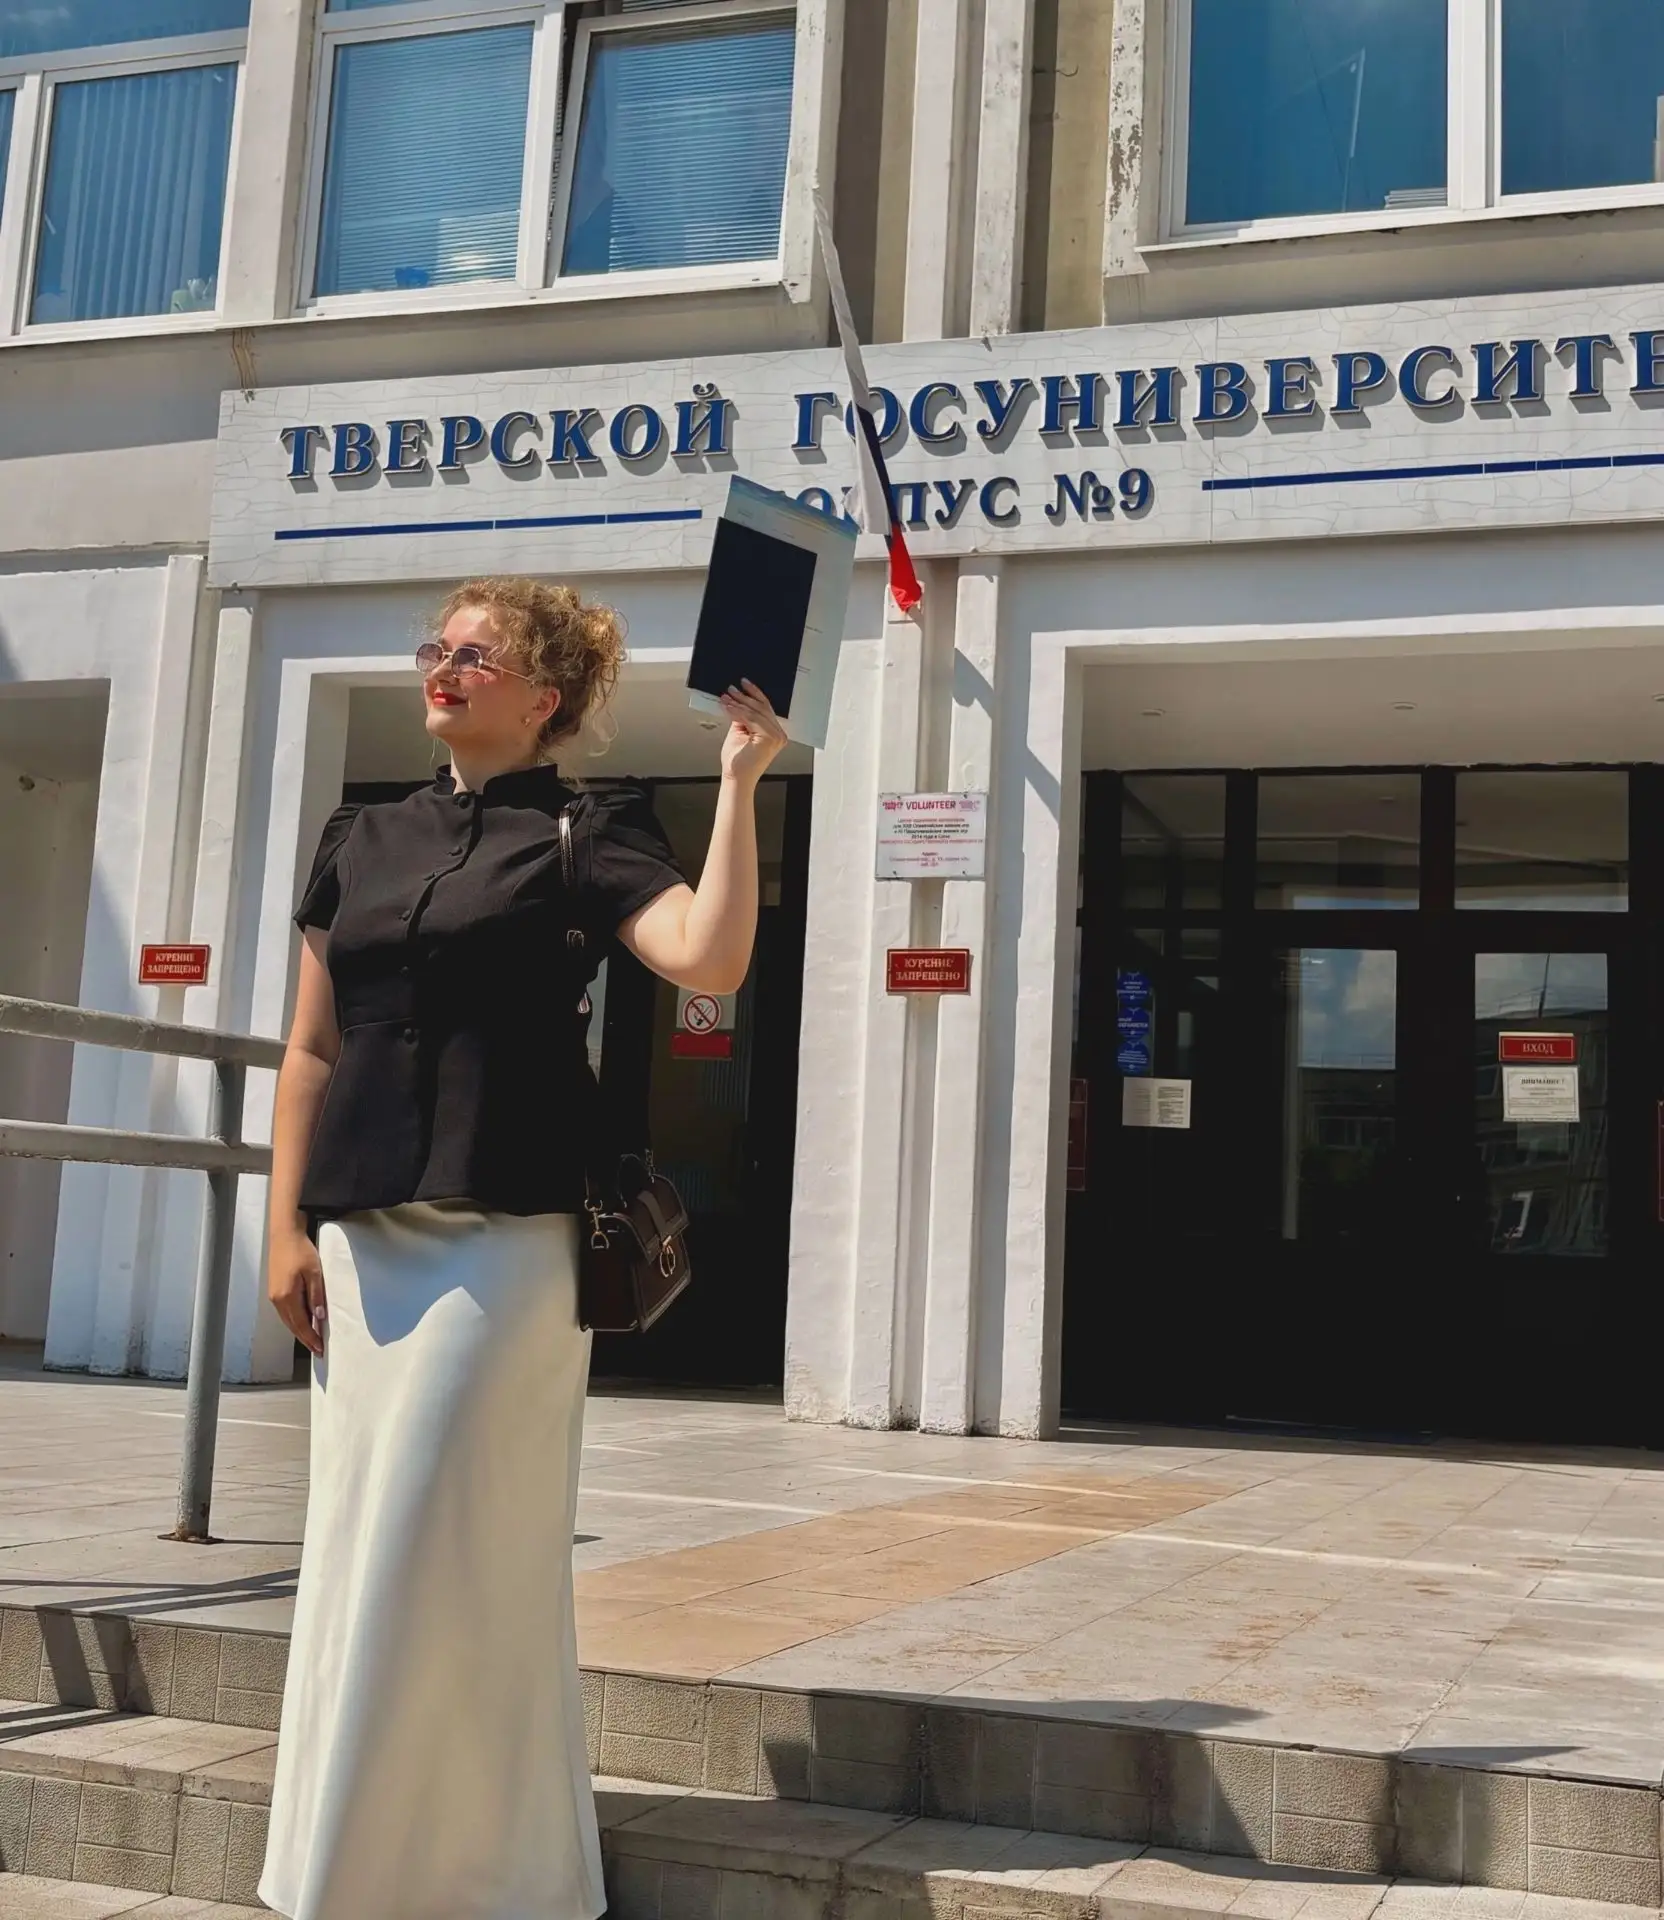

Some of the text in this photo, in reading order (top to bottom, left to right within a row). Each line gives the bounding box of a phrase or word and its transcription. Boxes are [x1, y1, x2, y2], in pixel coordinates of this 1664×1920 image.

[280, 382, 732, 480] ТВЕРСКОЙ
[1044, 467, 1151, 523] №9
[905, 800, 957, 810] VOLUNTEER
[155, 952, 195, 962] КУРЕНИЕ
[904, 958, 954, 968] КУРЕНИЕ
[147, 964, 201, 975] ЗАПРЕЩЕНО
[895, 971, 961, 982] ЗАПРЕЩЕНО
[1522, 1043, 1555, 1054] ВХОД
